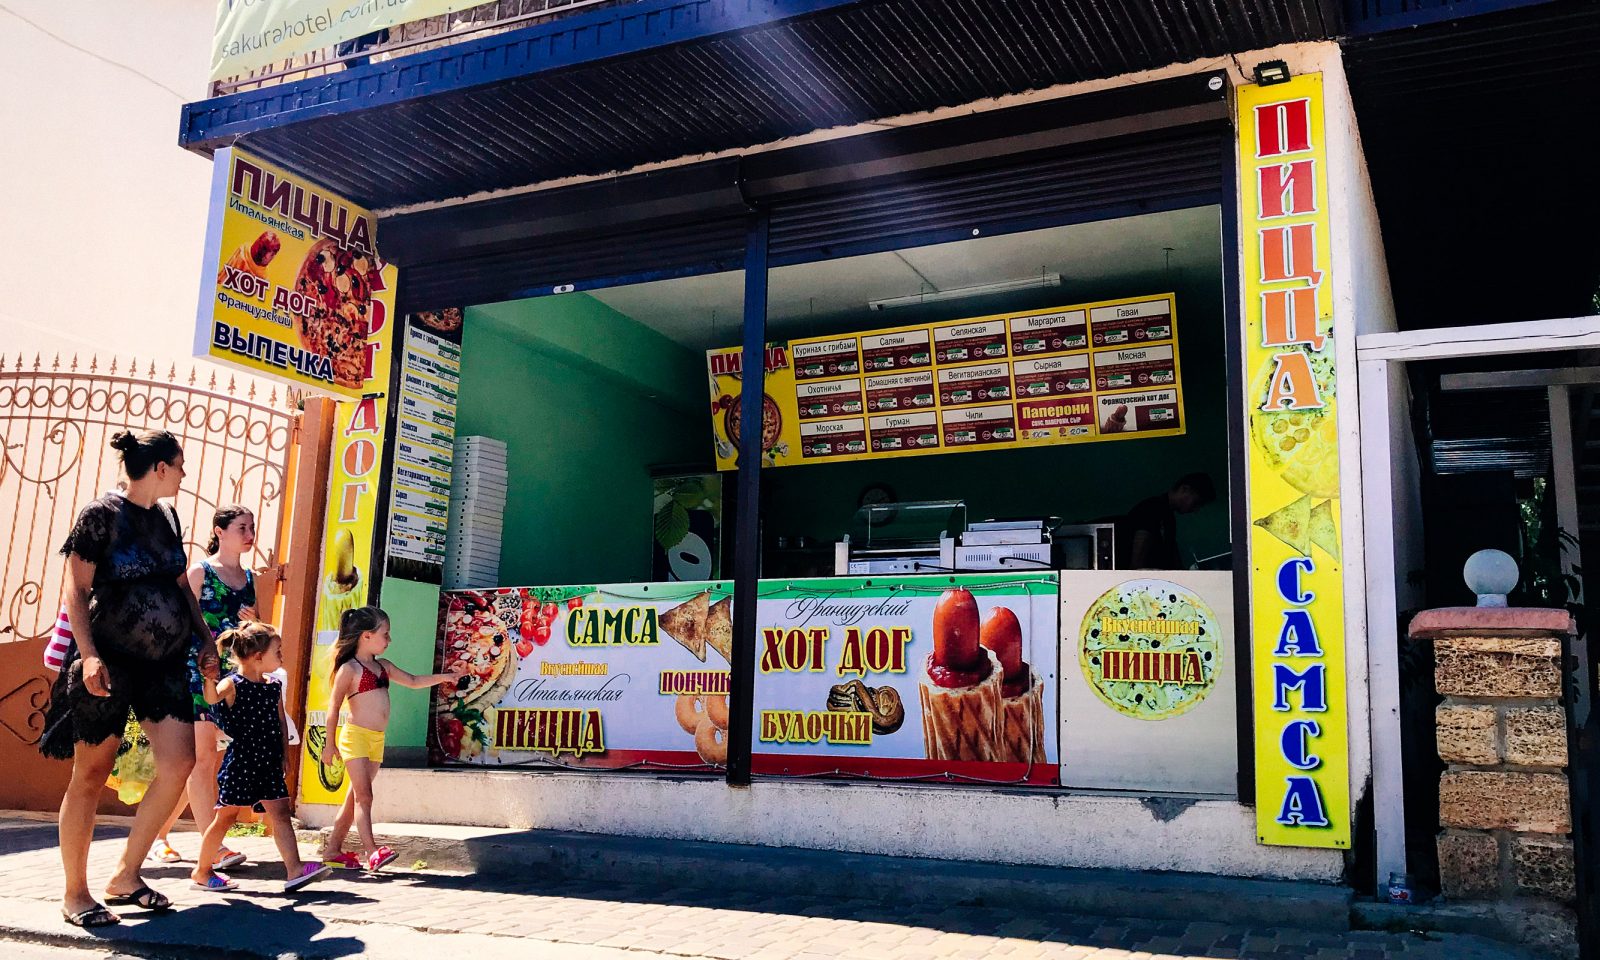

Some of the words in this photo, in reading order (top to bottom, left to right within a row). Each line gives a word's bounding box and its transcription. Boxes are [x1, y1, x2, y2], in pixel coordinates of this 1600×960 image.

[232, 156, 373, 256] ПИЦЦА
[229, 197, 305, 240] Итальянская
[1253, 98, 1327, 412] ПИЦЦА
[224, 264, 269, 301] ХОТ
[272, 287, 318, 317] ДОГ
[218, 291, 293, 328] Французский
[1028, 315, 1066, 327] Маргарита
[879, 336, 905, 346] Салями
[950, 325, 987, 337] Селянская
[213, 320, 335, 382] ВЫПЕЧКА
[795, 345, 821, 356] Куриная
[828, 341, 856, 354] грибами
[1117, 351, 1147, 361] Мясная
[1033, 360, 1062, 371] Сырная
[807, 384, 842, 394] Охотничья
[867, 378, 899, 388] Домашняя
[885, 418, 910, 428] Гурман
[965, 411, 983, 420] Чили
[1021, 403, 1090, 419] Паперони
[816, 423, 844, 434] Морская
[785, 591, 913, 628] Французский
[565, 605, 661, 648] САМСА
[1102, 616, 1200, 635] Вкуснейшая
[760, 626, 829, 673] ХОТ
[838, 625, 913, 678] ДОГ
[540, 661, 609, 678] Вкуснейшая
[1100, 649, 1205, 687] ПИЦЦА
[513, 674, 631, 703] Итальянская
[1272, 556, 1328, 827] САМСА
[494, 708, 605, 758] ПИЦЦА
[760, 710, 873, 745] БУЛОЧКИ
